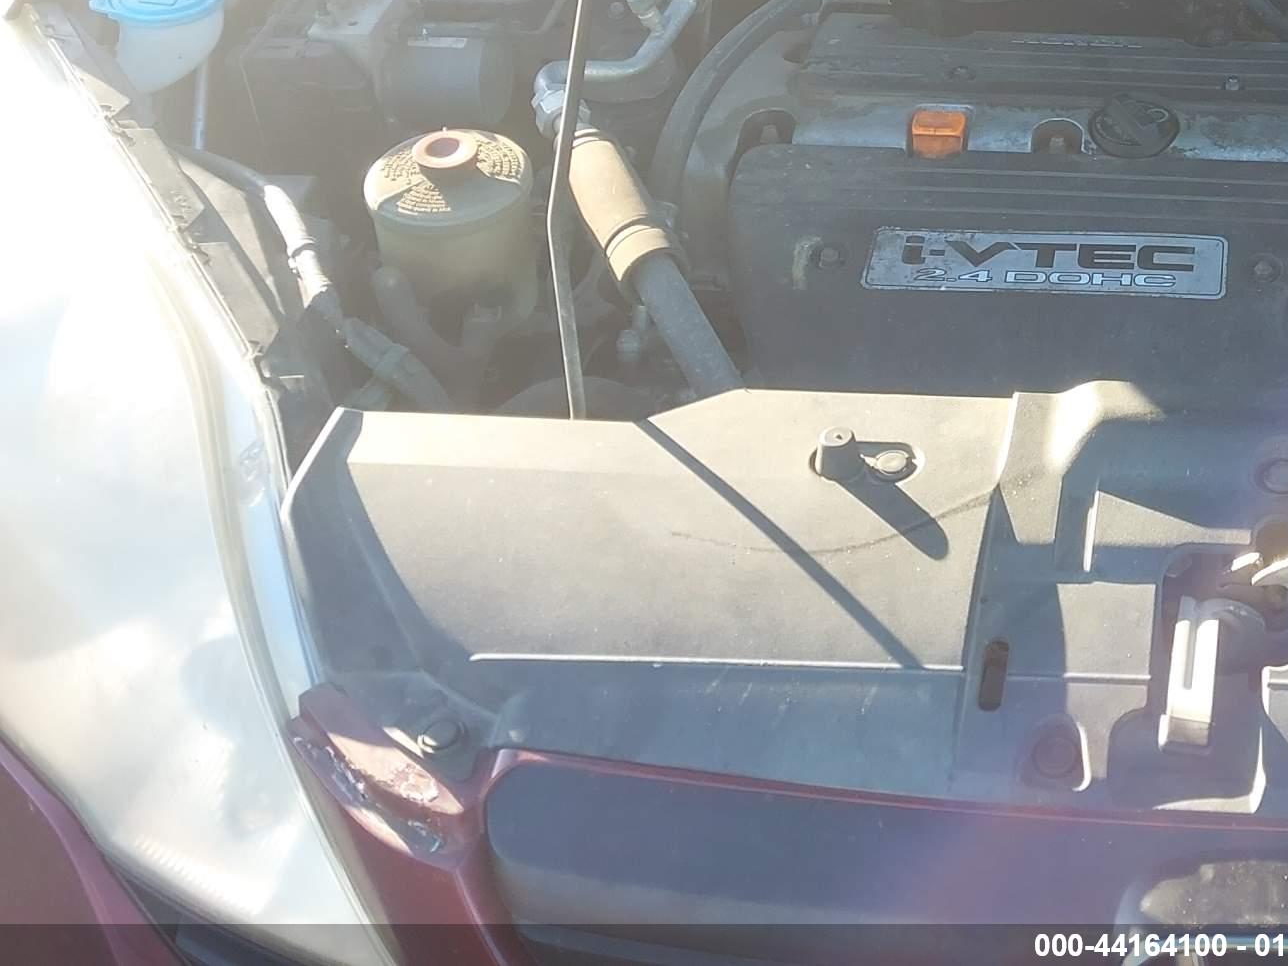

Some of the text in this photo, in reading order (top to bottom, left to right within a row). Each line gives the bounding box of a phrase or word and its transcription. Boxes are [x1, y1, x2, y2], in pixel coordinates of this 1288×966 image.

[902, 235, 1195, 272] i-VTEC
[914, 267, 1177, 287] 2.4 DOHC
